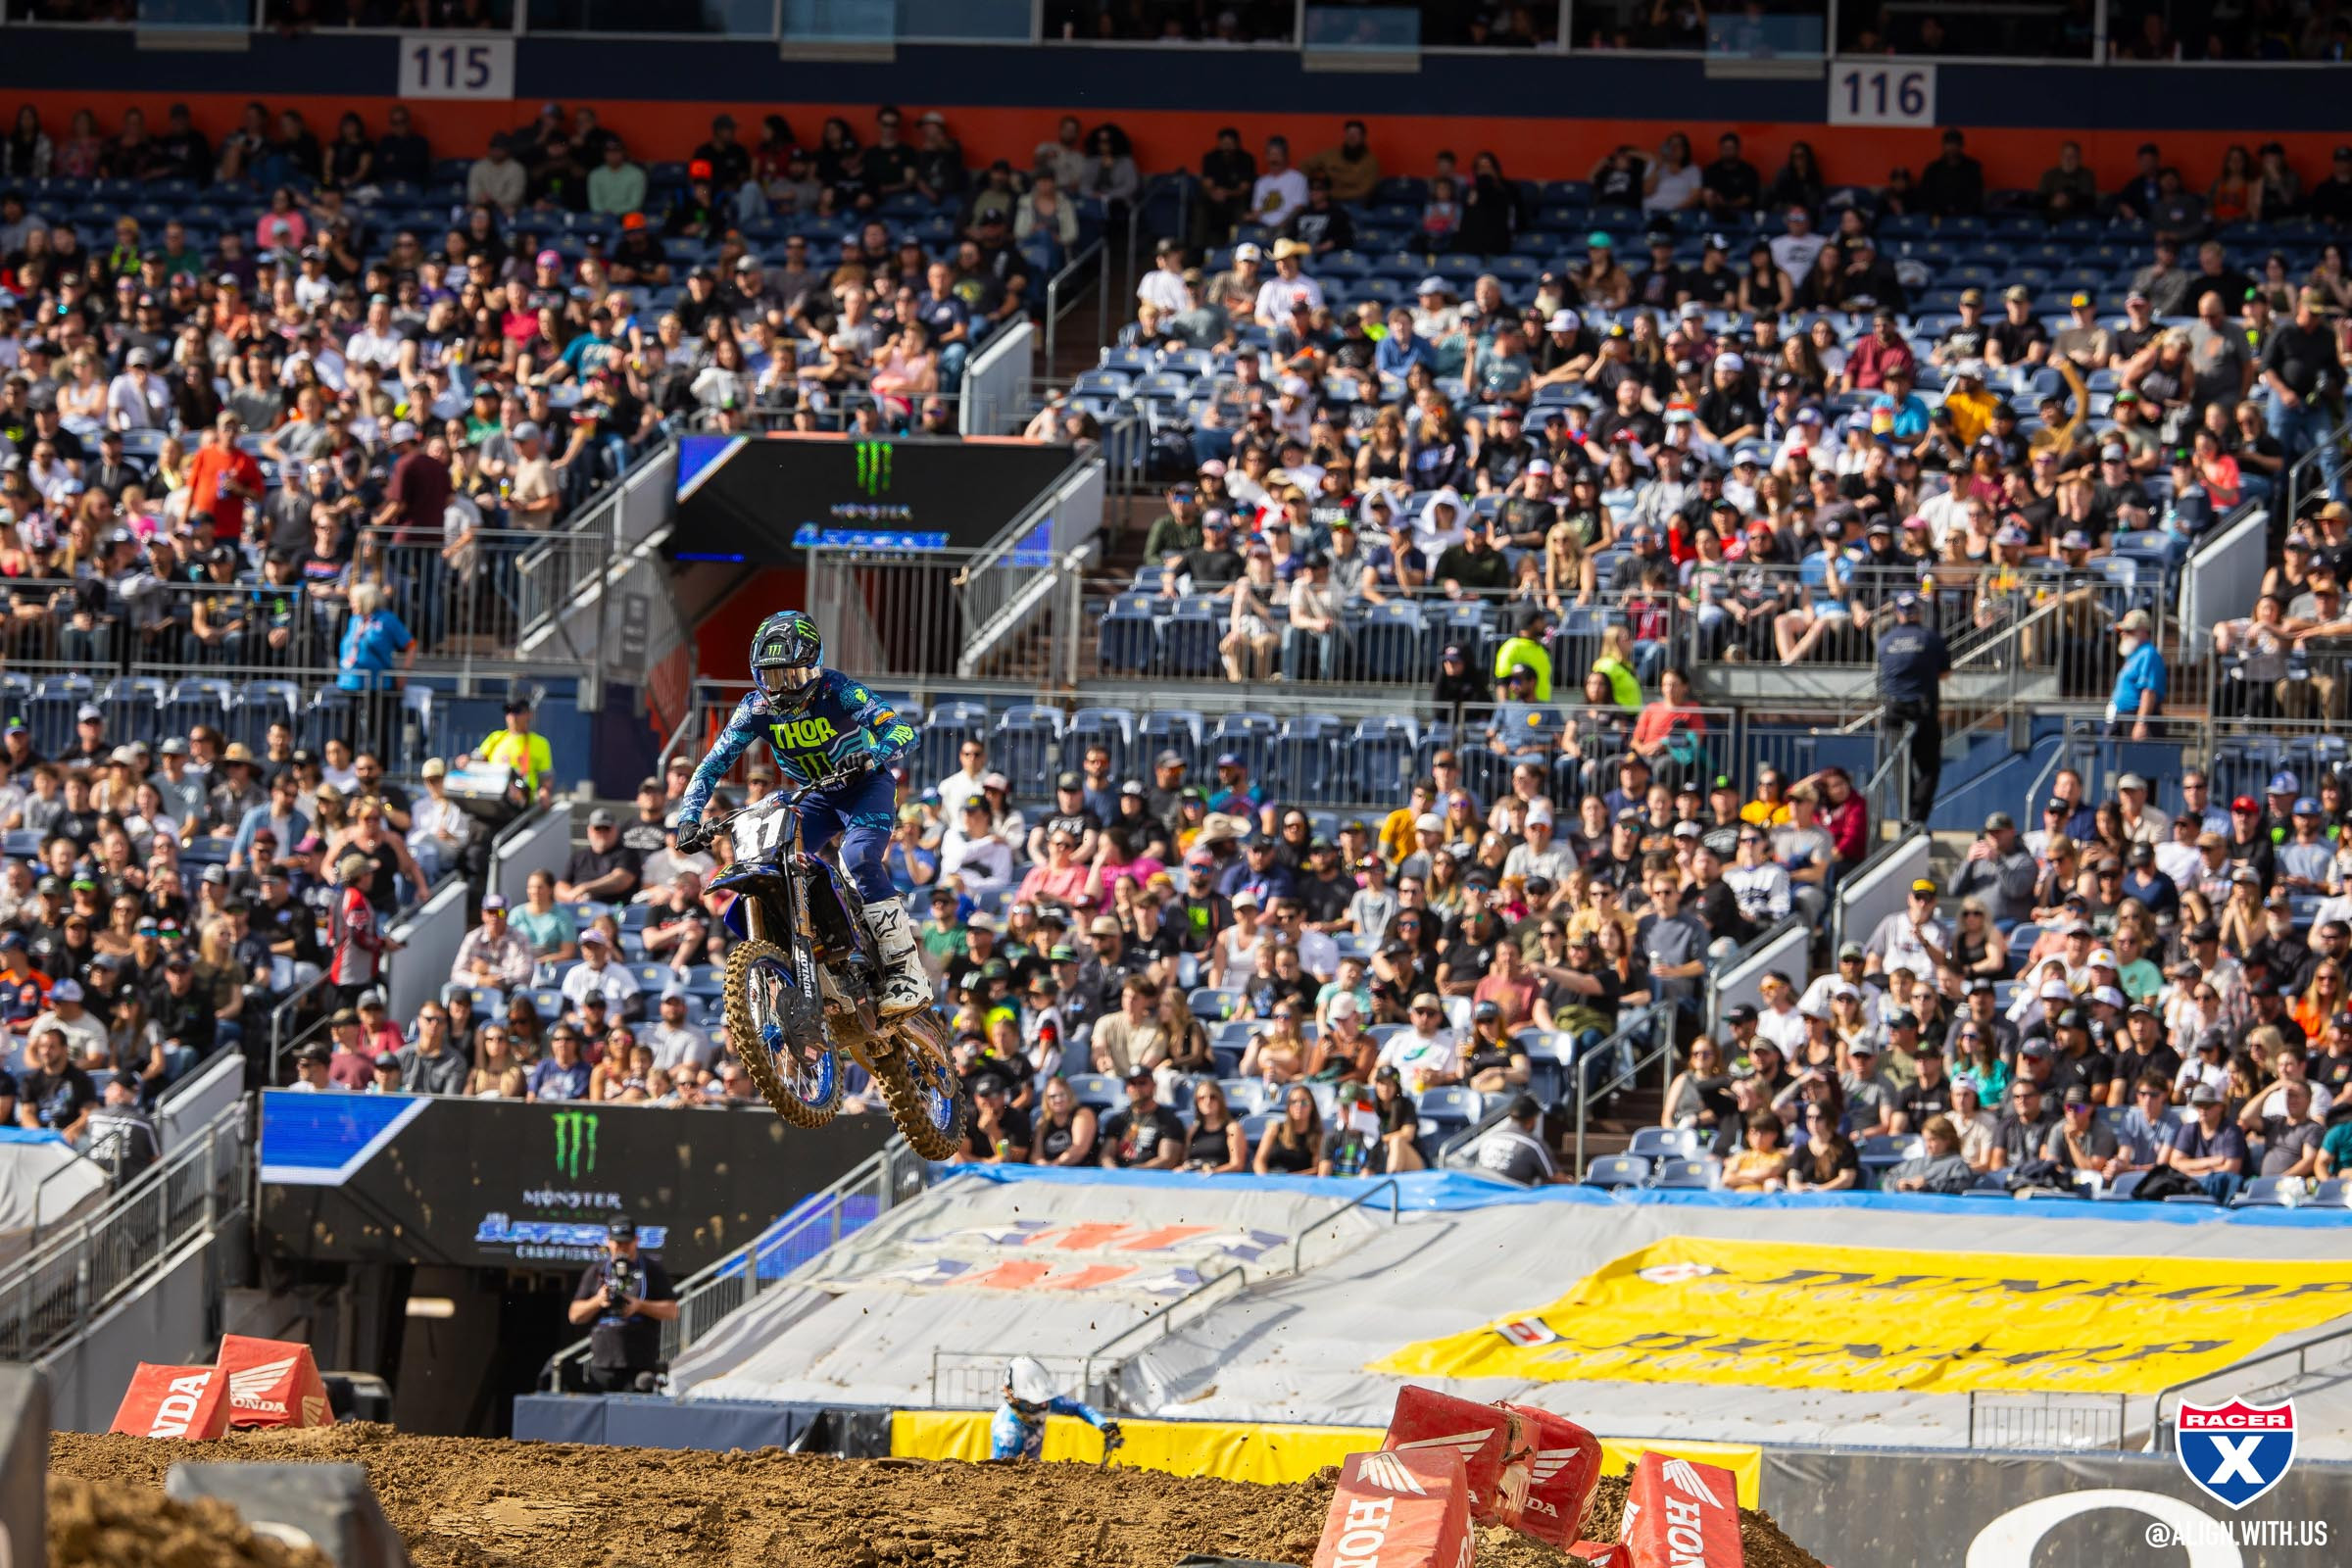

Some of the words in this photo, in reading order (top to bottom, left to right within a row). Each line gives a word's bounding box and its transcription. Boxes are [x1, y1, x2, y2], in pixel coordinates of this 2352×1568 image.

[413, 44, 491, 90] 115
[1843, 71, 1926, 118] 116
[769, 716, 838, 749] THOR
[731, 808, 786, 862] 31
[800, 950, 812, 999] DUNLOP
[522, 1189, 623, 1209] MONSTER
